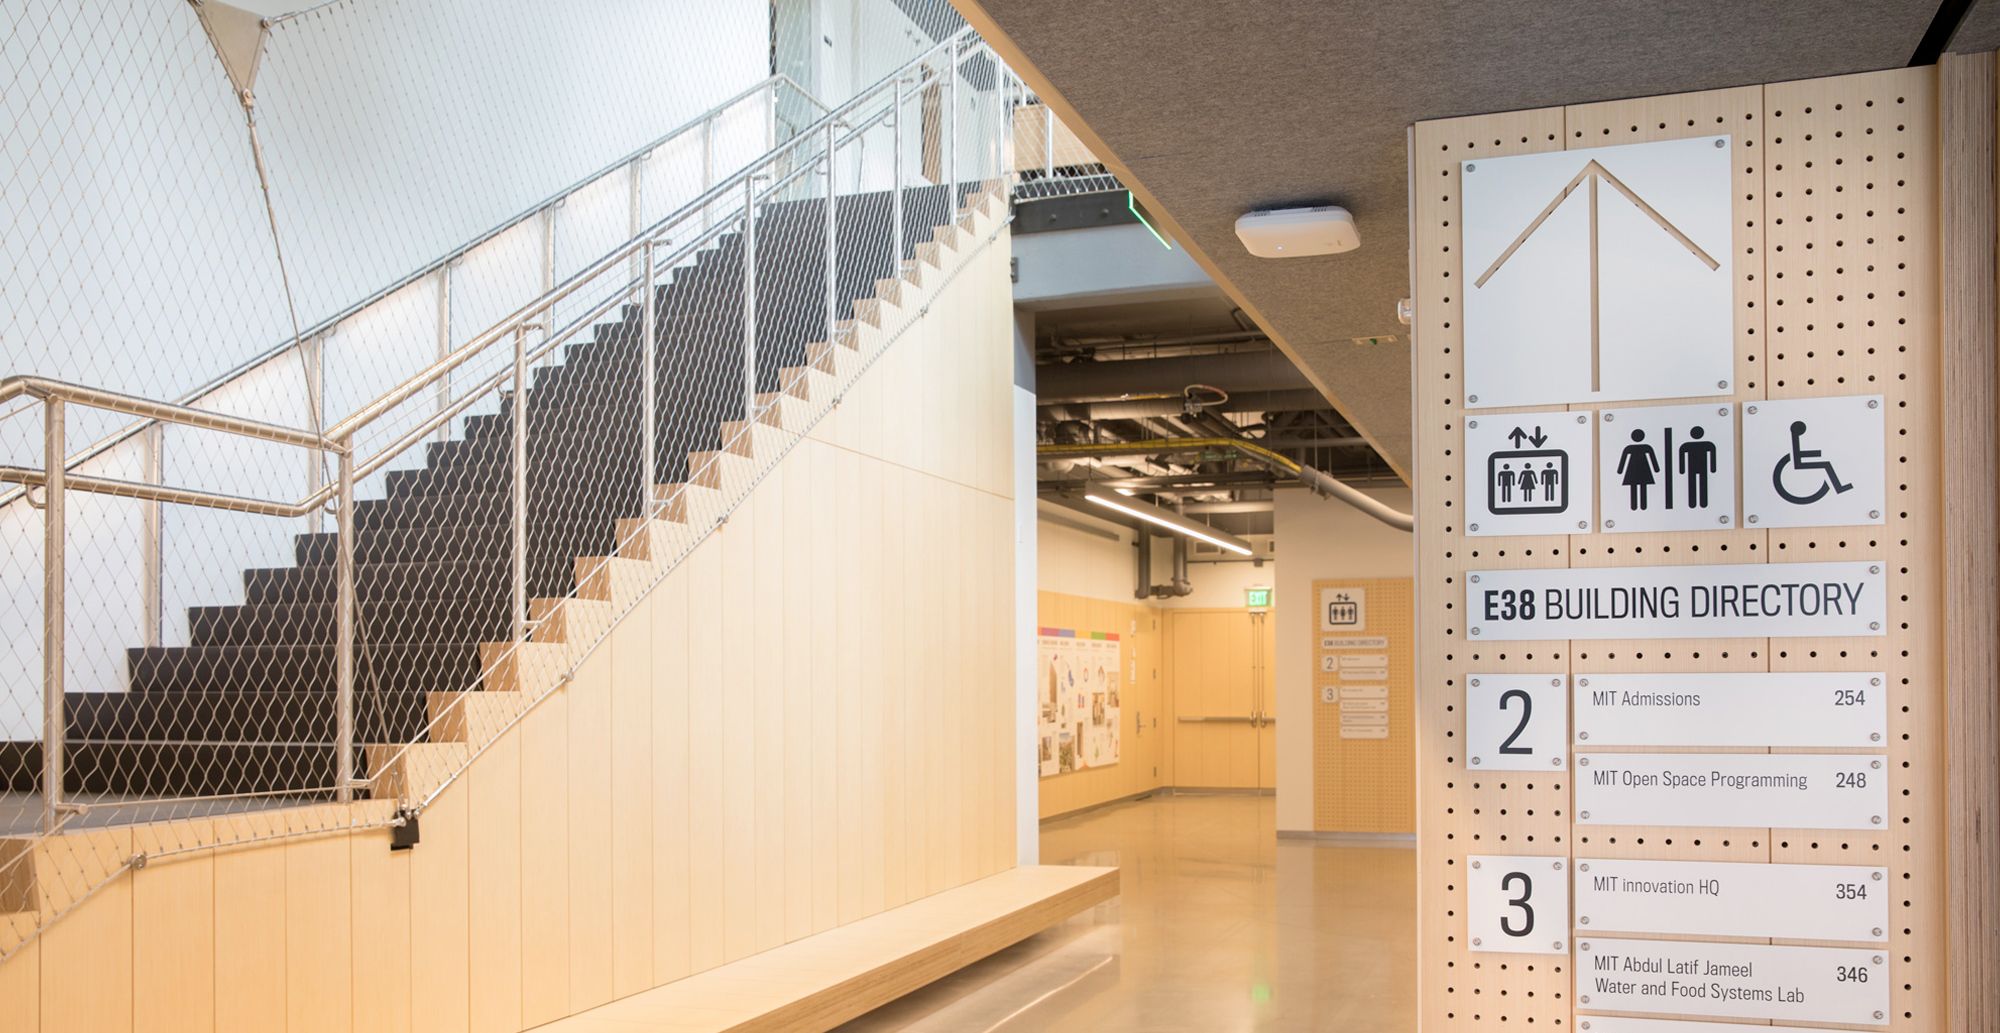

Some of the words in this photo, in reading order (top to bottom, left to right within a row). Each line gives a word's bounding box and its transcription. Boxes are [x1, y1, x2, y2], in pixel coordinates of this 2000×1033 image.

[1249, 591, 1267, 605] EXIT
[1484, 588, 1536, 622] E38
[1545, 585, 1680, 621] BUILDING
[1690, 581, 1865, 618] DIRECTORY
[1326, 657, 1334, 670] 2
[1326, 688, 1334, 701] 3
[1592, 690, 1618, 707] MIT
[1621, 690, 1701, 707] Admissions
[1834, 689, 1866, 707] 254
[1498, 688, 1534, 755] 2
[1593, 769, 1619, 786] MIT
[1622, 770, 1658, 789] Open
[1662, 770, 1707, 790] Space
[1711, 770, 1808, 791] Programming
[1835, 771, 1867, 789] 248
[1593, 875, 1619, 892] MIT
[1622, 878, 1694, 895] innovation
[1699, 878, 1720, 897] HQ
[1835, 883, 1868, 901] 354
[1499, 871, 1535, 938] 3
[1594, 954, 1620, 972] MIT
[1622, 956, 1663, 974] Abdul
[1667, 958, 1699, 975] Latif
[1703, 959, 1753, 978] Jameel
[1836, 965, 1869, 984] 346
[1594, 977, 1637, 995] Water
[1640, 980, 1667, 997] and
[1671, 980, 1706, 999] Food
[1710, 982, 1773, 1003] Systems
[1777, 986, 1805, 1004] Lab
